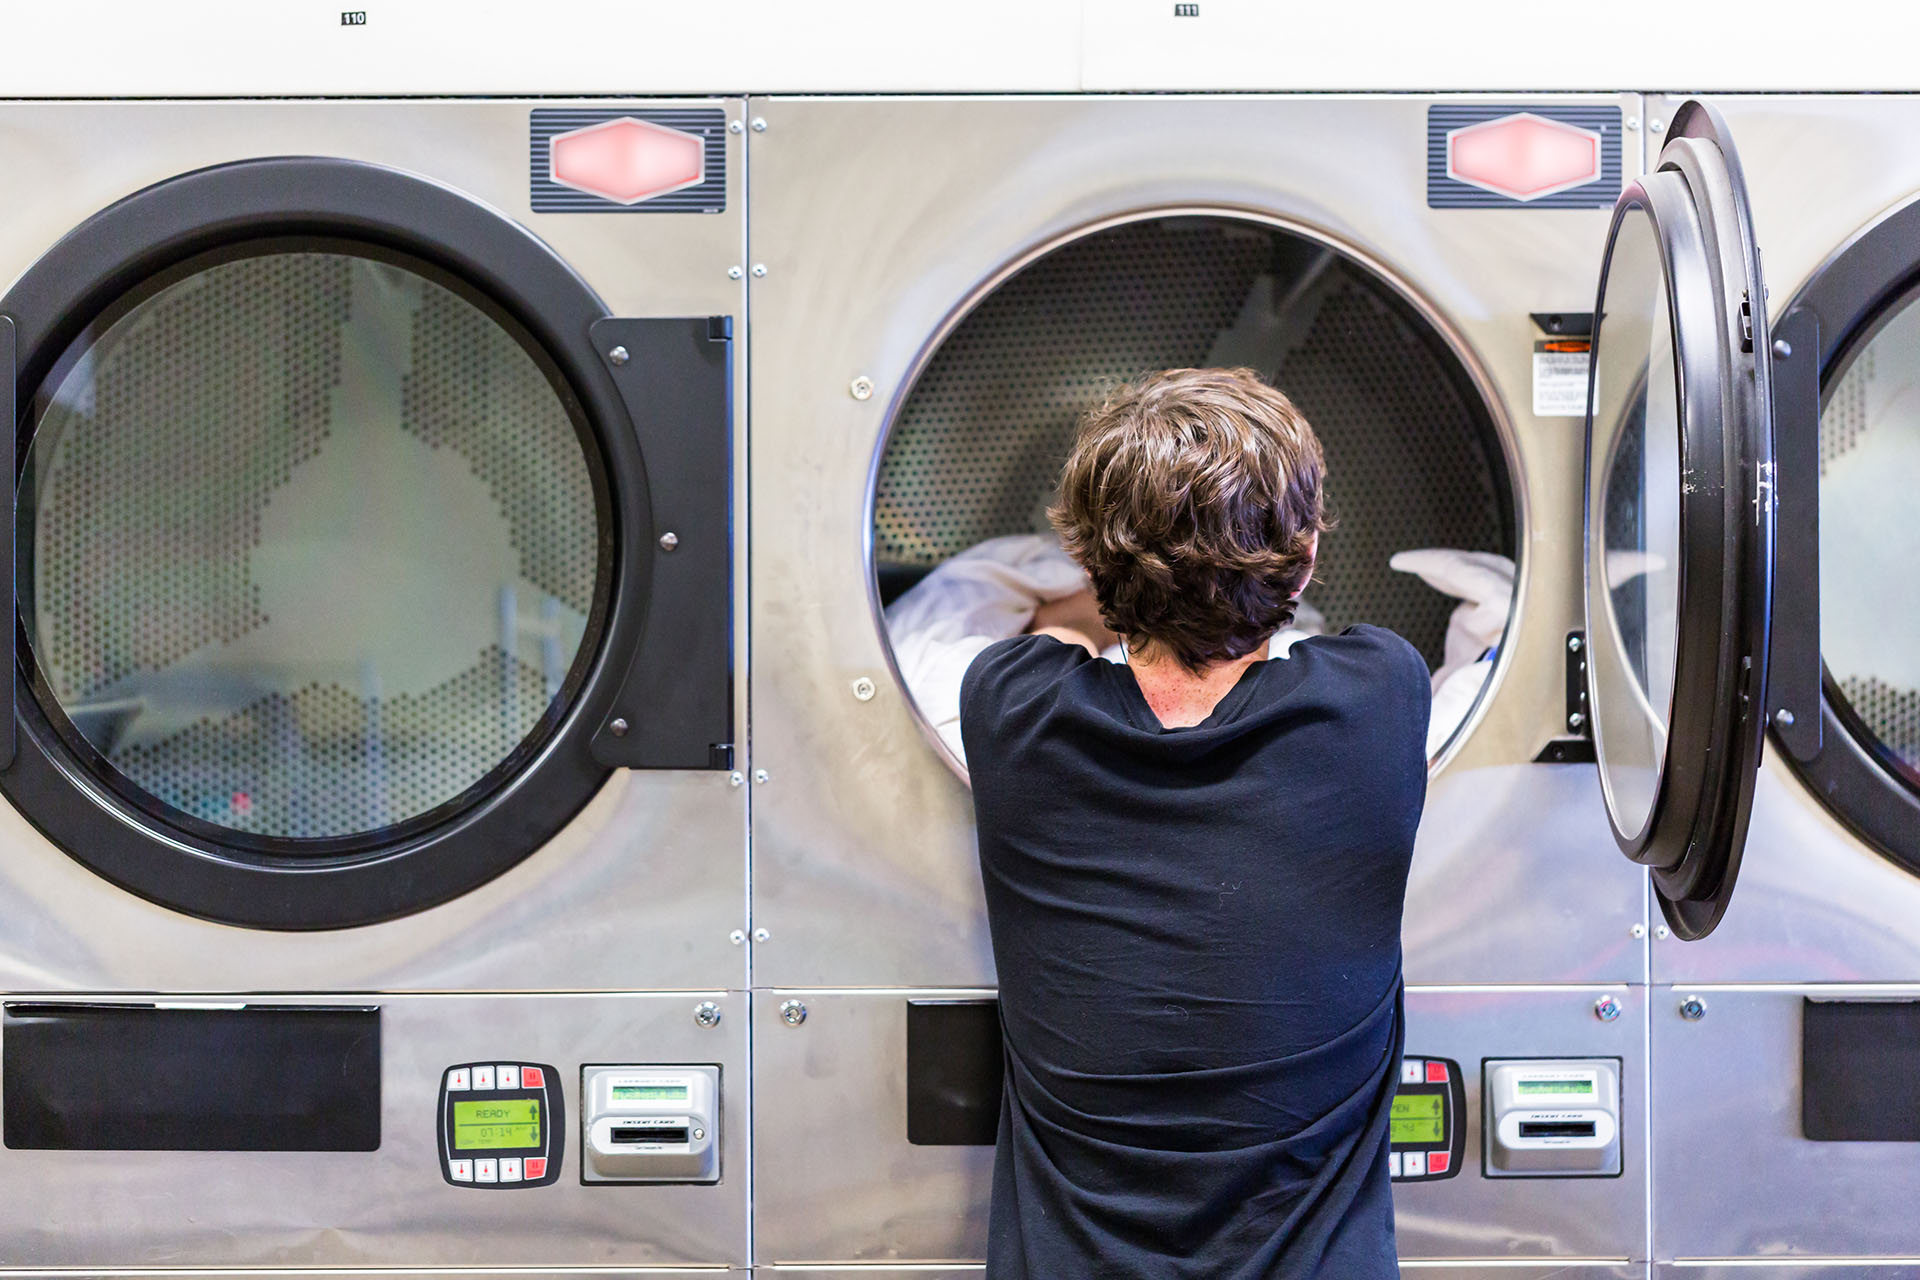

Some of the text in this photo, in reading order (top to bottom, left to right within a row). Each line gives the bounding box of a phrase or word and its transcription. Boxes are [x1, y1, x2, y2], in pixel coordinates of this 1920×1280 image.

[1177, 4, 1198, 16] 111
[343, 12, 365, 25] 110
[475, 1109, 511, 1119] READY
[480, 1127, 513, 1138] 07:14
